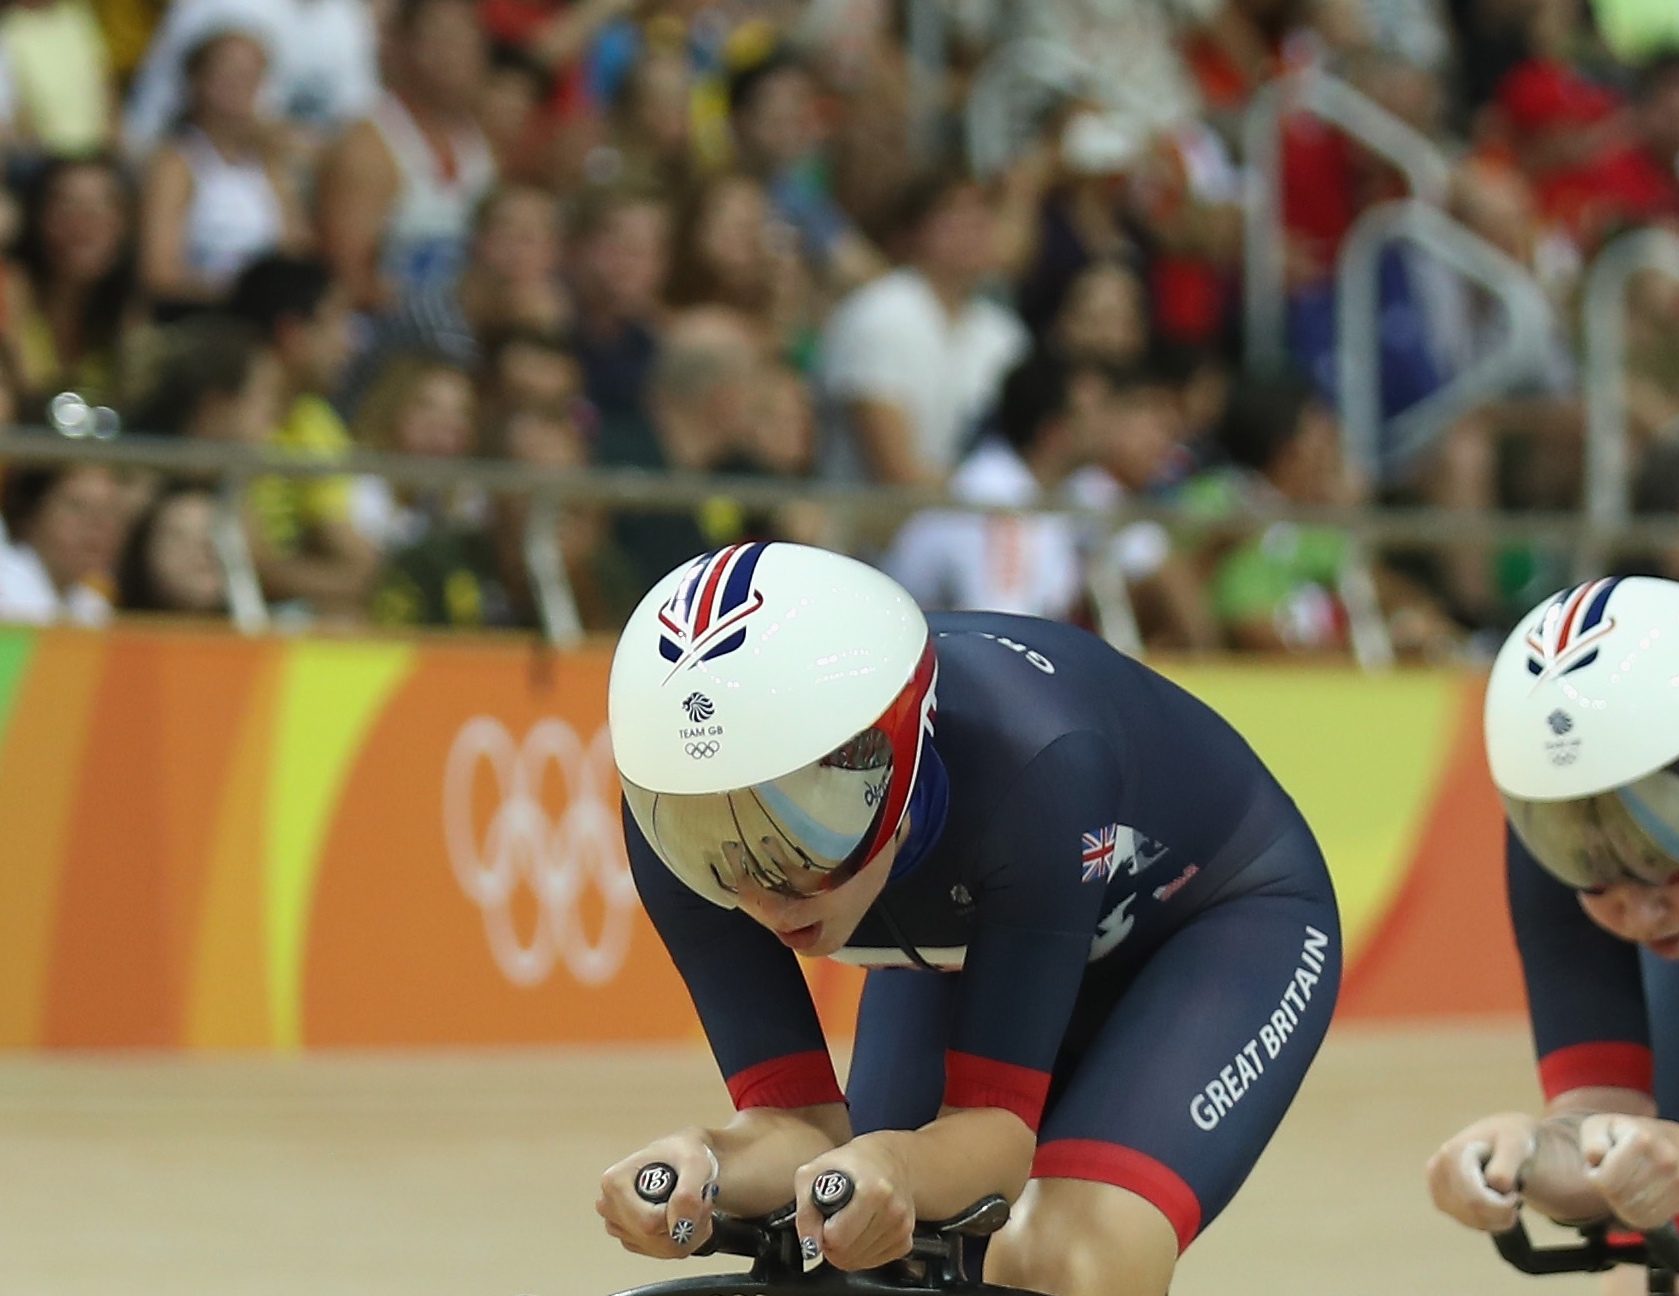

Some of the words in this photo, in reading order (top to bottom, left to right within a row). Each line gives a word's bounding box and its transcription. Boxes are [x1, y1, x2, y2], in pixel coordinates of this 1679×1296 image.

[679, 727, 705, 739] TEAM
[708, 725, 723, 736] GB
[1189, 1039, 1264, 1132] GREAT
[1258, 925, 1329, 1060] BRITAIN
